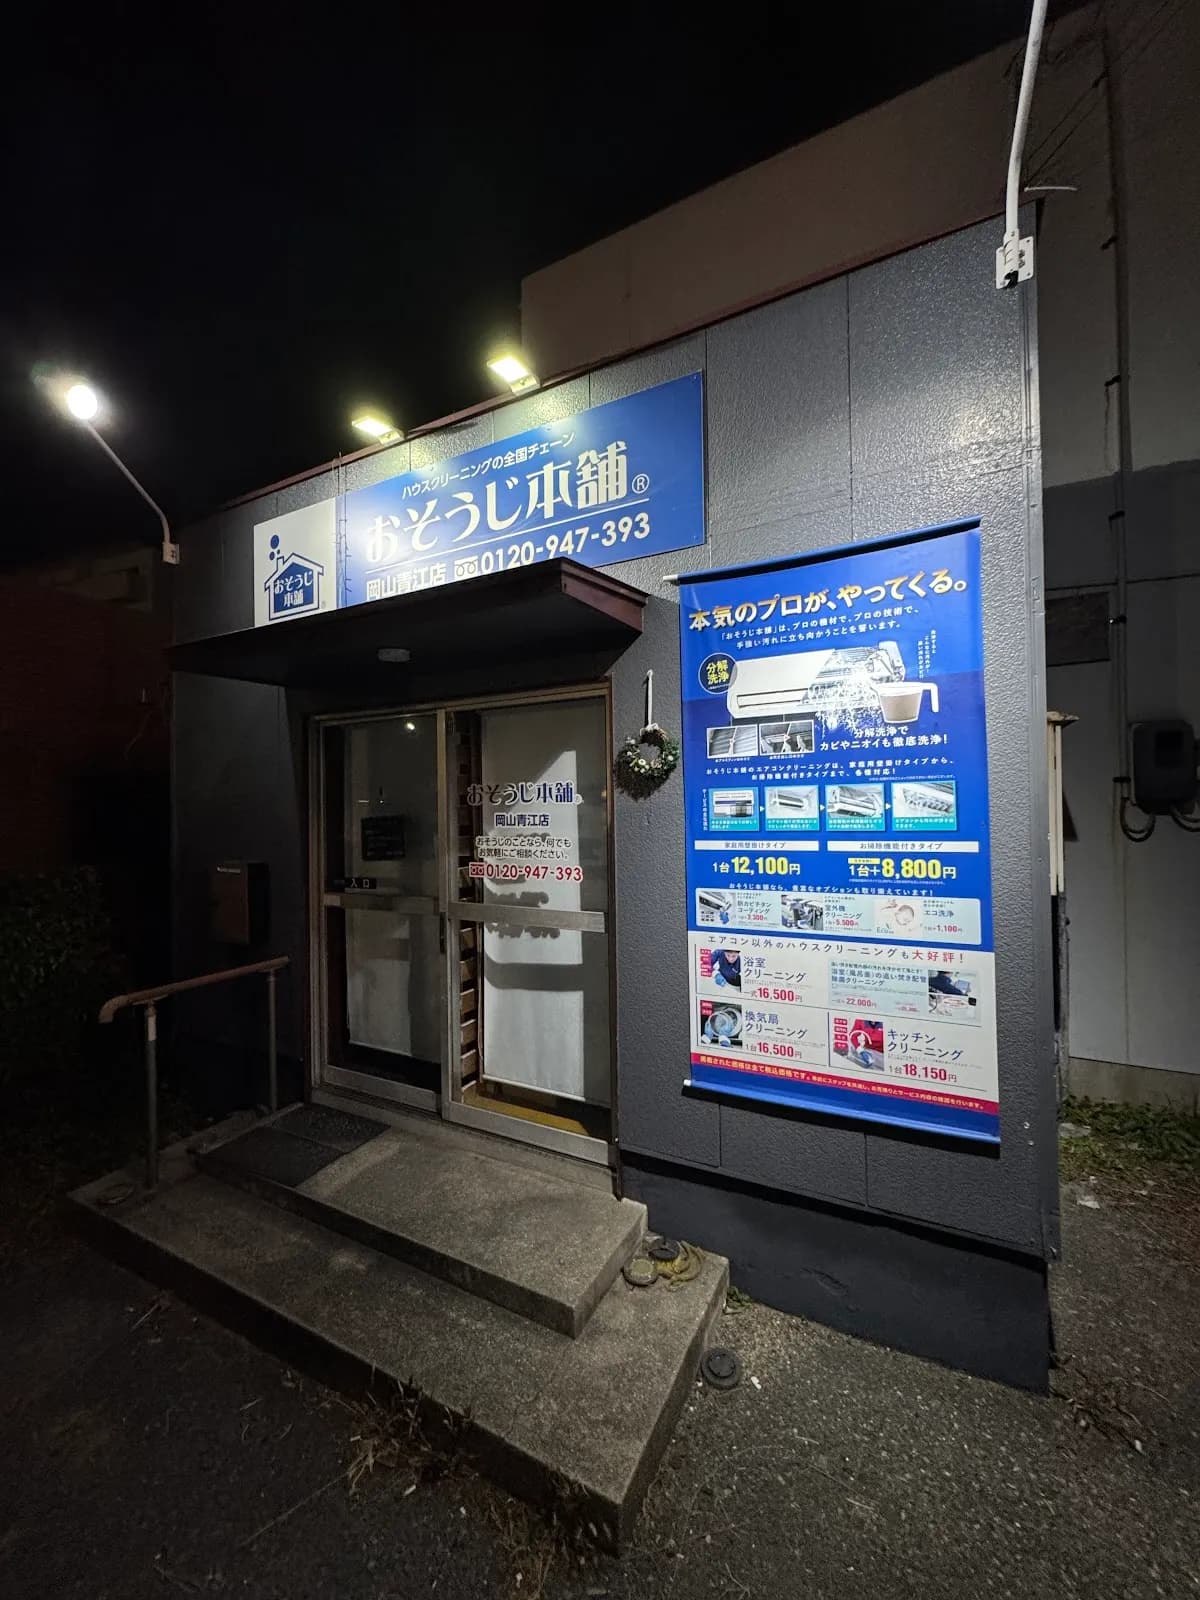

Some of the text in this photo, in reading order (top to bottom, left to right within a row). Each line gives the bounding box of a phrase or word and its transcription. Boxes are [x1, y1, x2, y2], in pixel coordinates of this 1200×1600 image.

[402, 432, 575, 500] ハウスクリーニングの全国チェーン
[481, 512, 650, 574] 0120-947-393
[273, 570, 314, 595] おそうじ
[366, 563, 448, 601] 岡山青江店
[283, 589, 304, 608] 本舗
[689, 568, 967, 632] 本気のプロが、やってくる。
[706, 660, 729, 674] 分解
[707, 671, 730, 686] 洗浄
[854, 726, 909, 739] 分解洗浄で
[495, 813, 550, 827] 岡山青江店
[476, 837, 572, 849] おそうじのことなら、何でも
[479, 848, 568, 860] お気軽にご相談ください。
[486, 863, 582, 882] 0120-947-393
[743, 955, 767, 969] 浴室
[743, 967, 807, 983] クリーニング
[745, 1010, 780, 1025] 換気扇
[745, 1022, 808, 1039] クリーニング
[887, 1028, 937, 1044] キッチン
[887, 1041, 964, 1061] クリーニング
